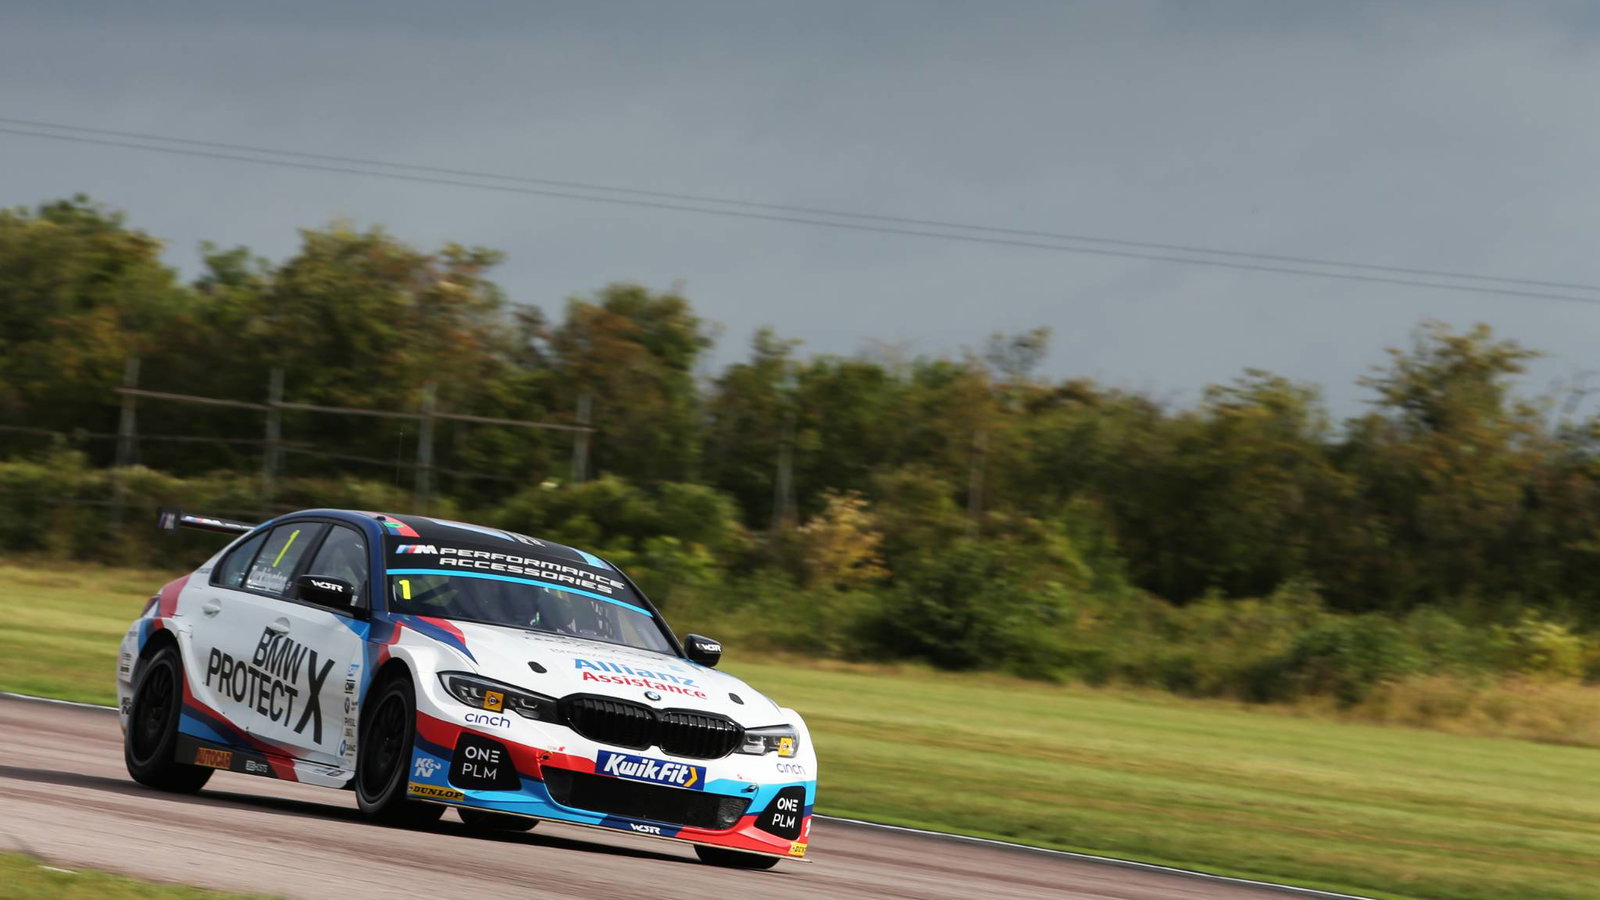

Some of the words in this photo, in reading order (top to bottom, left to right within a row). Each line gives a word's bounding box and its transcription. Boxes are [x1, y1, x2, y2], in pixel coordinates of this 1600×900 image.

[271, 529, 300, 568] 1
[439, 557, 613, 595] ACCESSORIES
[440, 547, 625, 590] PERFORMANCE
[311, 579, 343, 592] WSR
[398, 579, 412, 600] 1
[253, 626, 308, 685] BMW
[574, 658, 700, 688] Allianz
[205, 647, 298, 727] PROTECT
[582, 672, 708, 700] Assistance
[293, 649, 336, 745] X
[465, 713, 511, 728] cinch
[464, 746, 500, 763] ONE
[414, 757, 442, 777] K&N
[462, 763, 498, 780] PLM
[776, 762, 806, 775] cinch
[413, 785, 463, 799] DUNLOP
[777, 797, 798, 812] ONE
[630, 823, 661, 835] WSR
[772, 813, 795, 829] PLM
